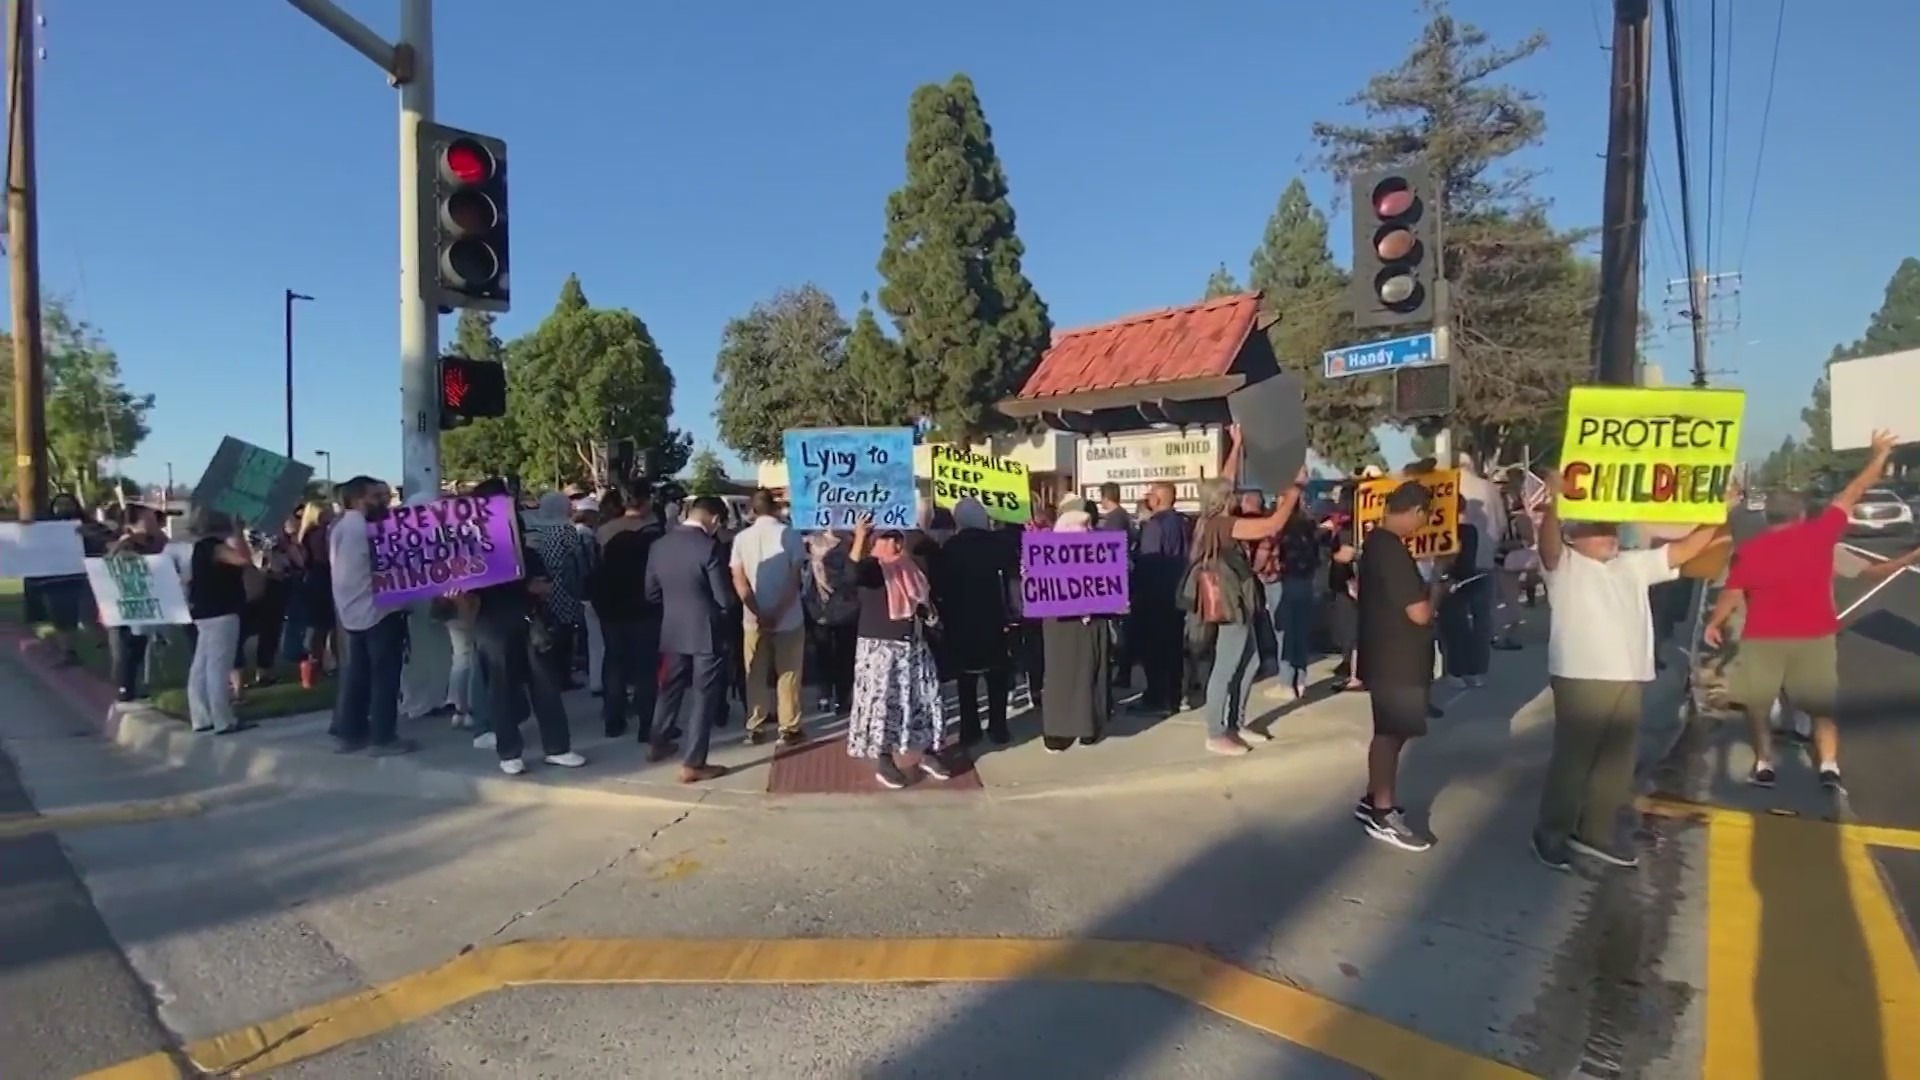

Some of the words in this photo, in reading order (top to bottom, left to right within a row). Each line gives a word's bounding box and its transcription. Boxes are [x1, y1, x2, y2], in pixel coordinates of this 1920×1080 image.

[1348, 348, 1394, 367] Handy
[1578, 414, 1735, 449] PROTECT
[801, 441, 857, 478] Lying
[867, 445, 889, 465] to
[1086, 446, 1127, 461] ORANGE
[1165, 440, 1210, 456] UNIFIED
[938, 465, 983, 483] KEEP
[1106, 468, 1140, 479] SCHOOL
[1143, 465, 1186, 478] DISTRICT
[1562, 461, 1733, 503] CHILDREN
[817, 481, 892, 503] Parents
[936, 479, 1019, 511] SECRETS
[376, 498, 495, 534] TREVOR
[815, 505, 831, 527] is
[368, 518, 490, 553] PROJECT
[370, 537, 495, 573] EXPLOITS
[1029, 542, 1121, 567] PROTECT
[373, 556, 489, 594] MINORS
[1024, 575, 1123, 602] CHILDREN
